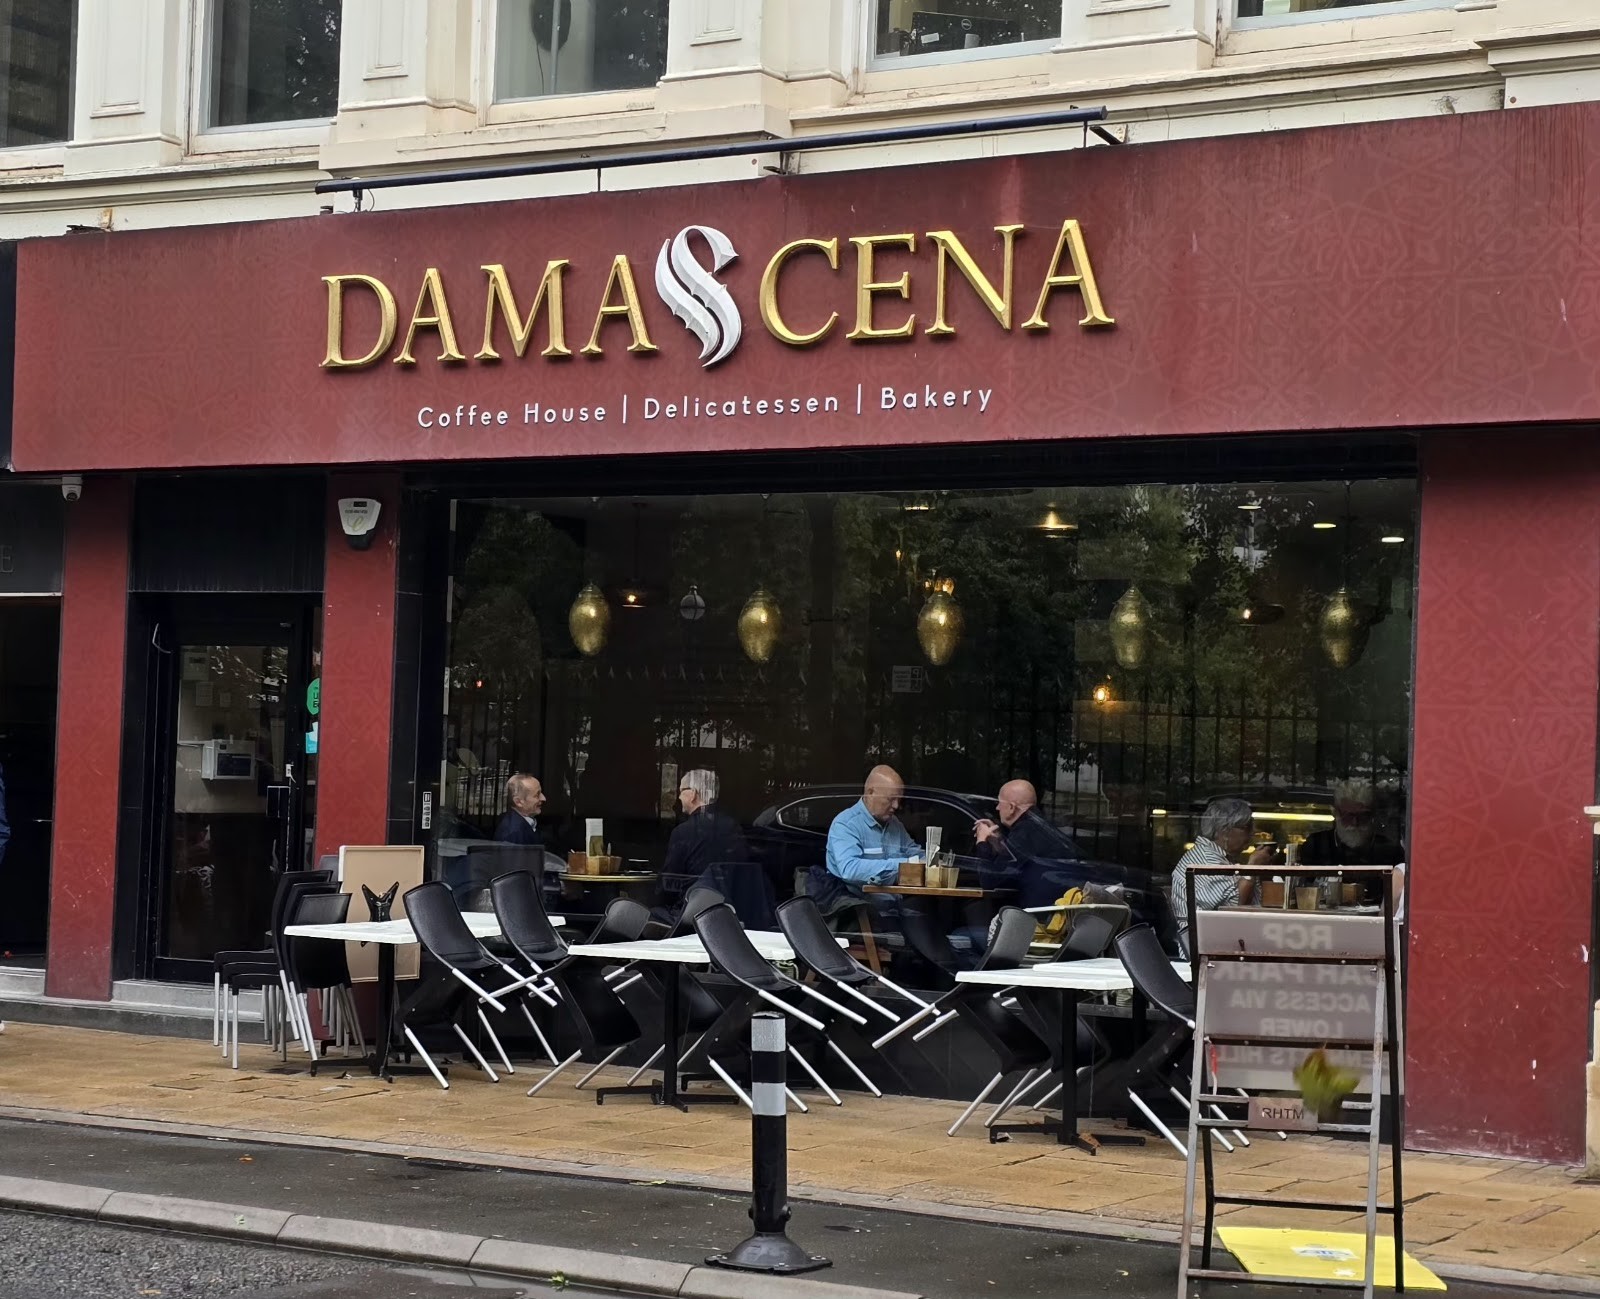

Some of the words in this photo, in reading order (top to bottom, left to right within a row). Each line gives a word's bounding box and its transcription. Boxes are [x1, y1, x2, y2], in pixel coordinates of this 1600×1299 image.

[319, 219, 1115, 368] DAMASCENA
[417, 405, 509, 428] Coffee
[523, 402, 606, 424] House
[644, 395, 838, 420] Delicatessen
[880, 384, 992, 412] Bakery
